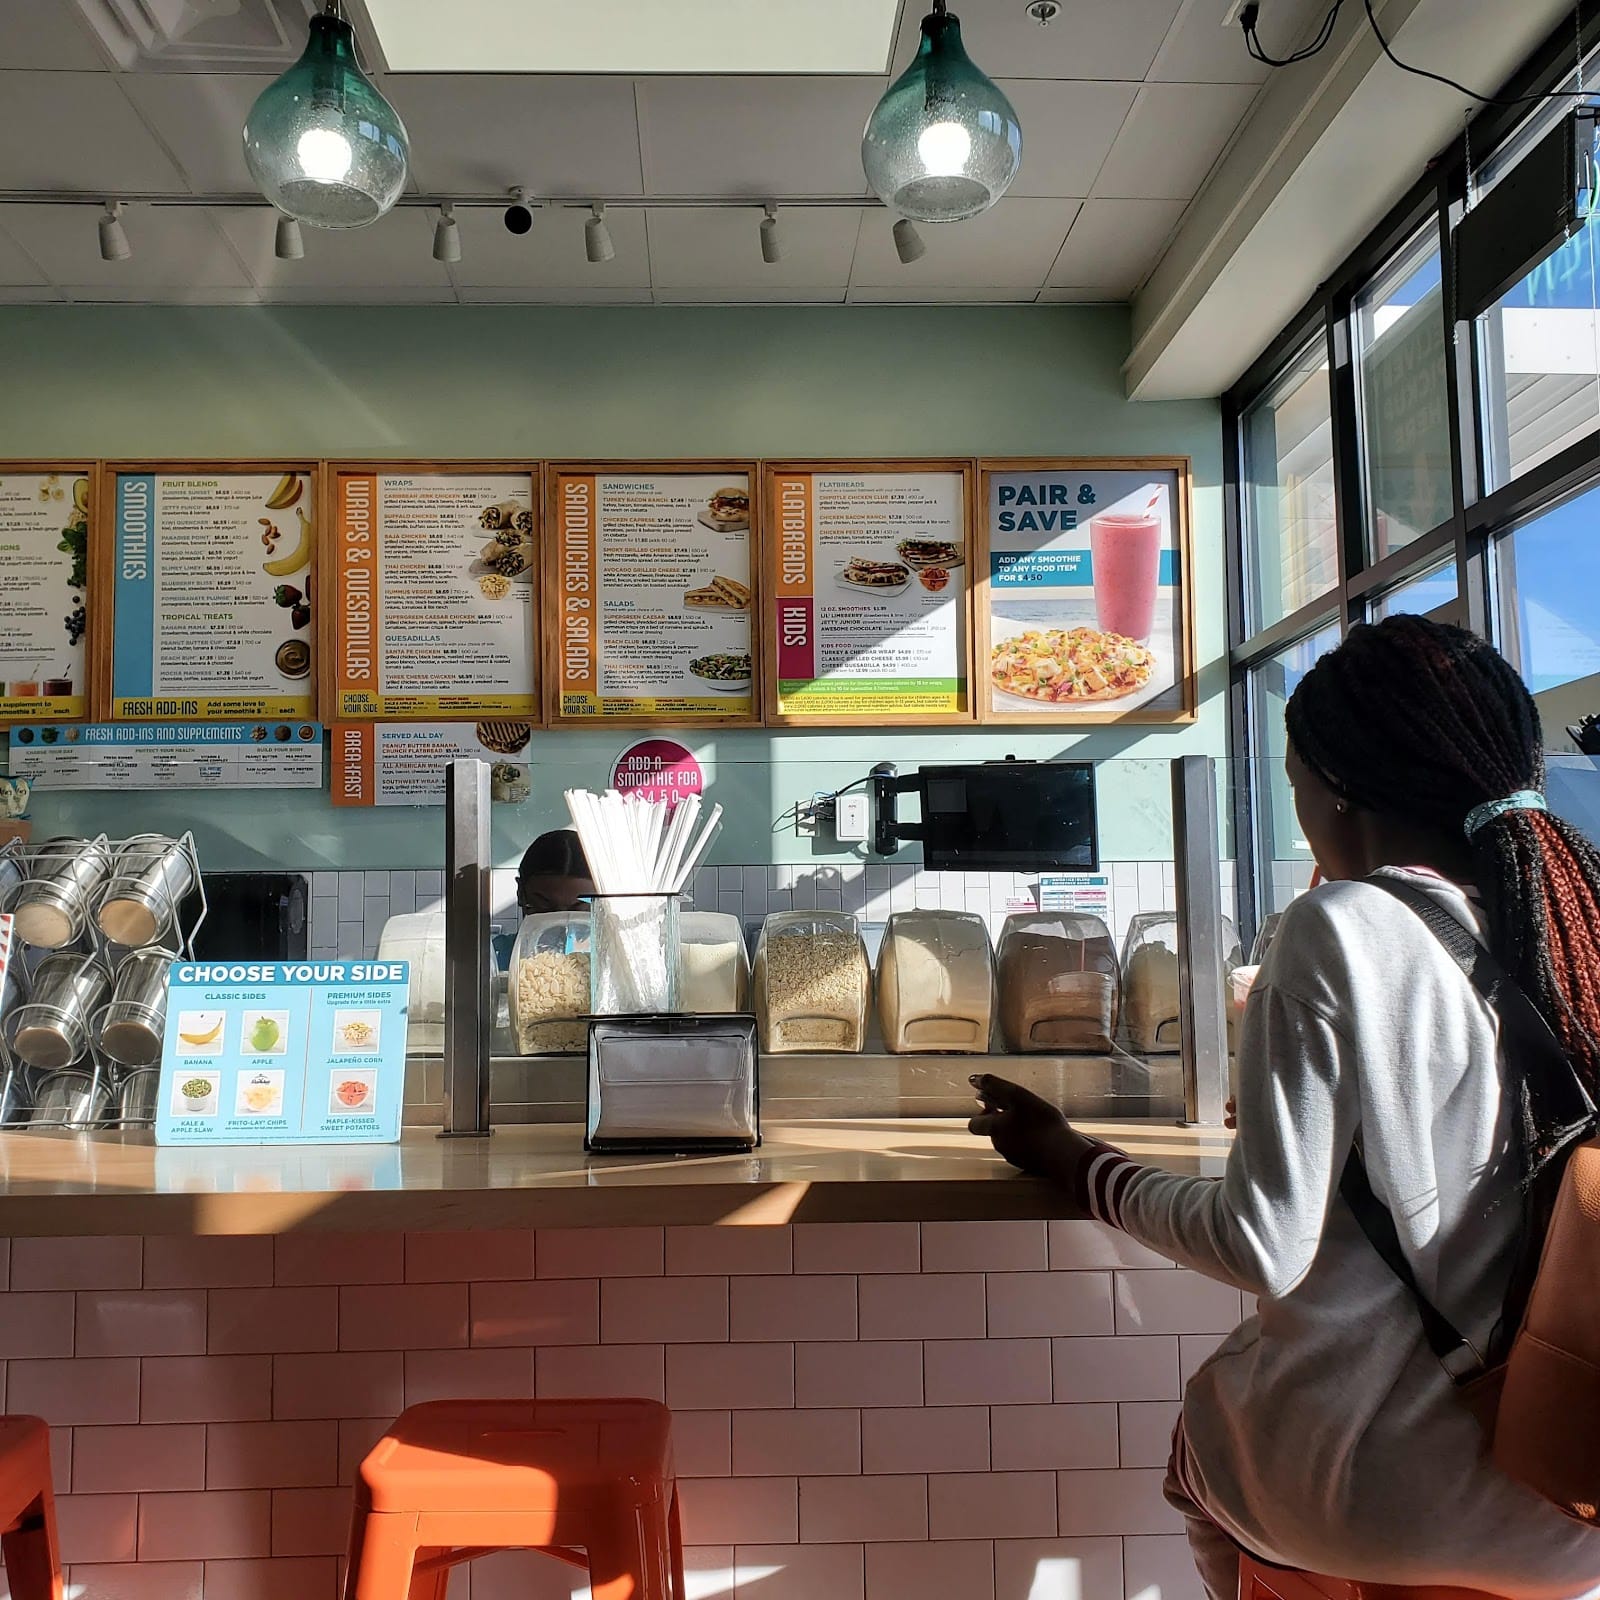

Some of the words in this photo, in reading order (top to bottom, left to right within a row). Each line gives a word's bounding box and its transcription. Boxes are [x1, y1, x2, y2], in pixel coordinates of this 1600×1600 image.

[999, 484, 1067, 505] PAIR
[1077, 484, 1096, 504] &
[346, 481, 370, 542] WRAPS
[998, 510, 1077, 531] SAVE
[123, 482, 147, 580] SMOOTHIES
[565, 483, 588, 592] SANDWICHES
[782, 482, 806, 584] FLATBREADS
[346, 548, 371, 563] &
[567, 597, 590, 612] &
[344, 568, 370, 680] QUESADILLAS
[784, 607, 806, 646] KIDS
[566, 616, 589, 680] SALADS
[344, 694, 368, 703] CHOOSE
[564, 696, 588, 704] CHOOSE
[123, 701, 152, 715] FRESH
[156, 701, 198, 715] ADD-INS
[344, 704, 362, 713] YOUR
[363, 704, 377, 712] SIDE
[564, 706, 581, 714] YOUR
[582, 706, 596, 714] SIDE
[86, 728, 113, 740] FRESH
[116, 728, 153, 740] ADD-INS
[157, 727, 176, 739] AND
[629, 756, 650, 770] ADD
[654, 756, 662, 770] A
[618, 772, 674, 786] SMOOTHIE
[678, 771, 697, 785] FOR
[179, 966, 275, 982] CHOOSE
[278, 965, 344, 981] YOUR
[351, 964, 403, 980] SIDE
